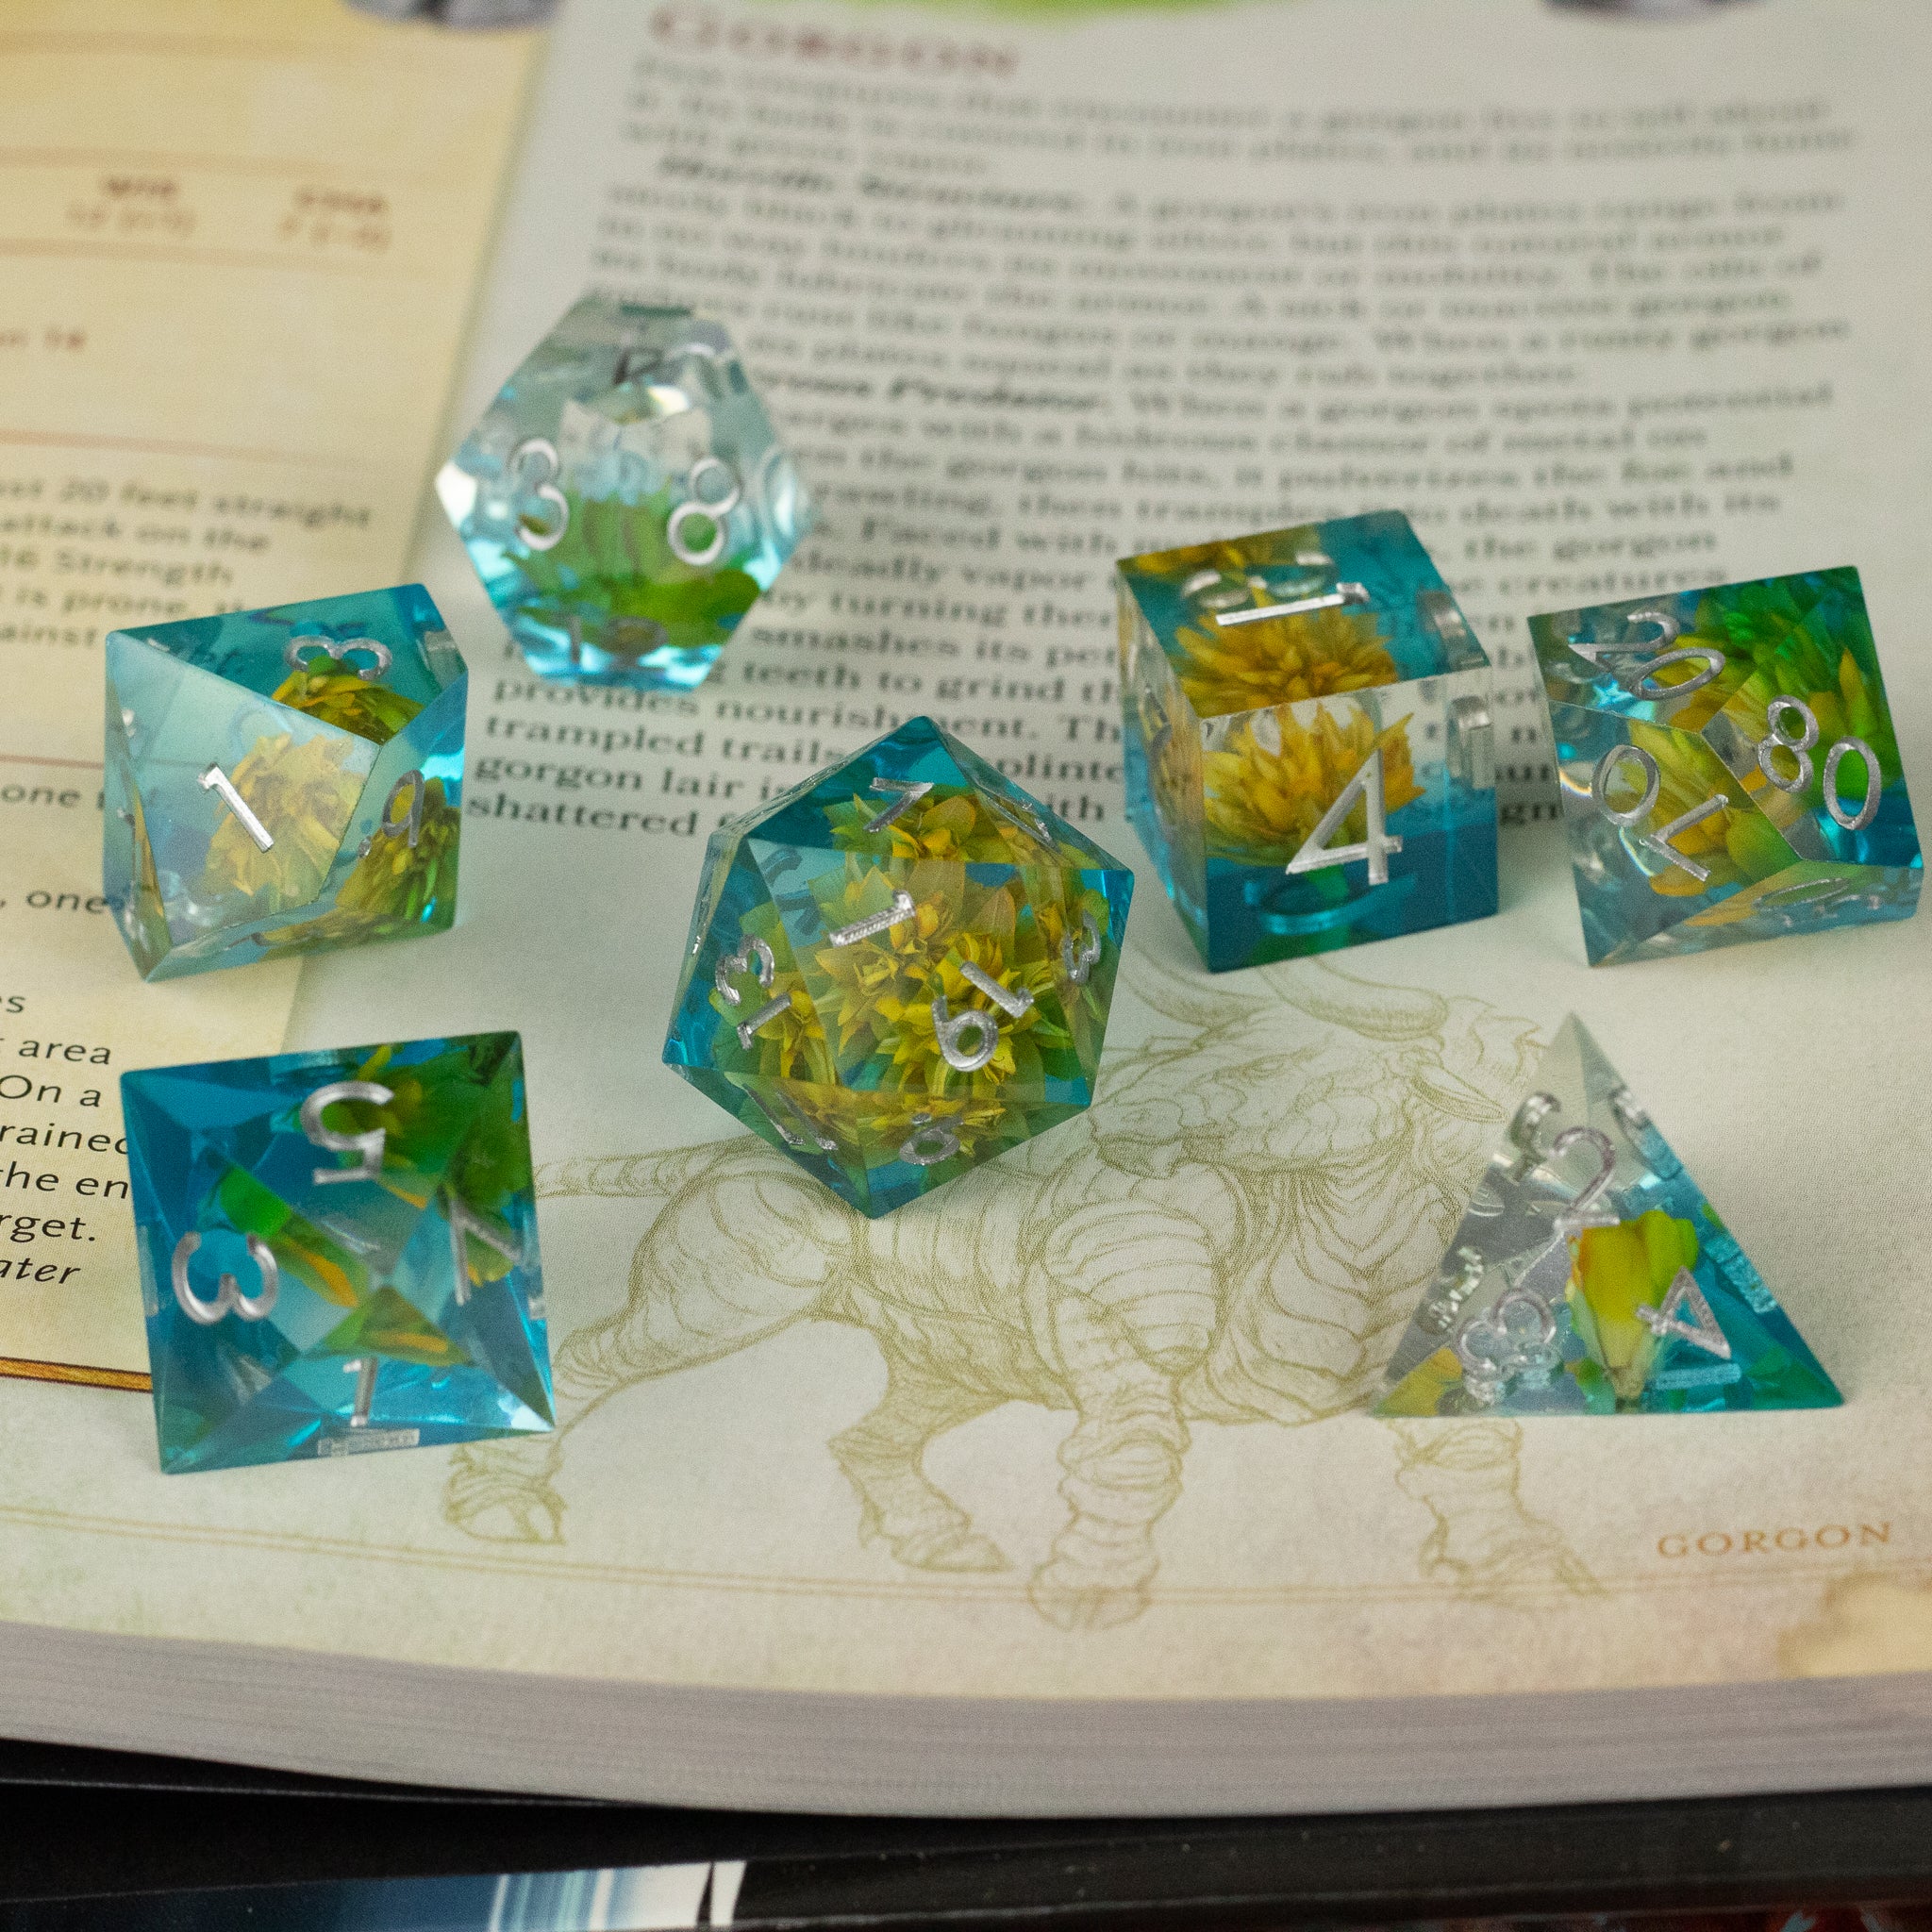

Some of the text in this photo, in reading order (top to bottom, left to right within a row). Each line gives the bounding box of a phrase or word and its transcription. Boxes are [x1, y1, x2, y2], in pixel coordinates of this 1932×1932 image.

[484, 714, 705, 755] trampled
[473, 755, 644, 794] gorgon
[660, 765, 745, 799] lair
[1757, 693, 1882, 831] 80
[465, 791, 701, 838] shattered
[1284, 747, 1404, 886] 4
[18, 1040, 111, 1065] area
[0, 1074, 102, 1108] On a
[298, 1080, 394, 1185] 5
[171, 1230, 279, 1325] 3
[1656, 1520, 1892, 1559] GORGON
